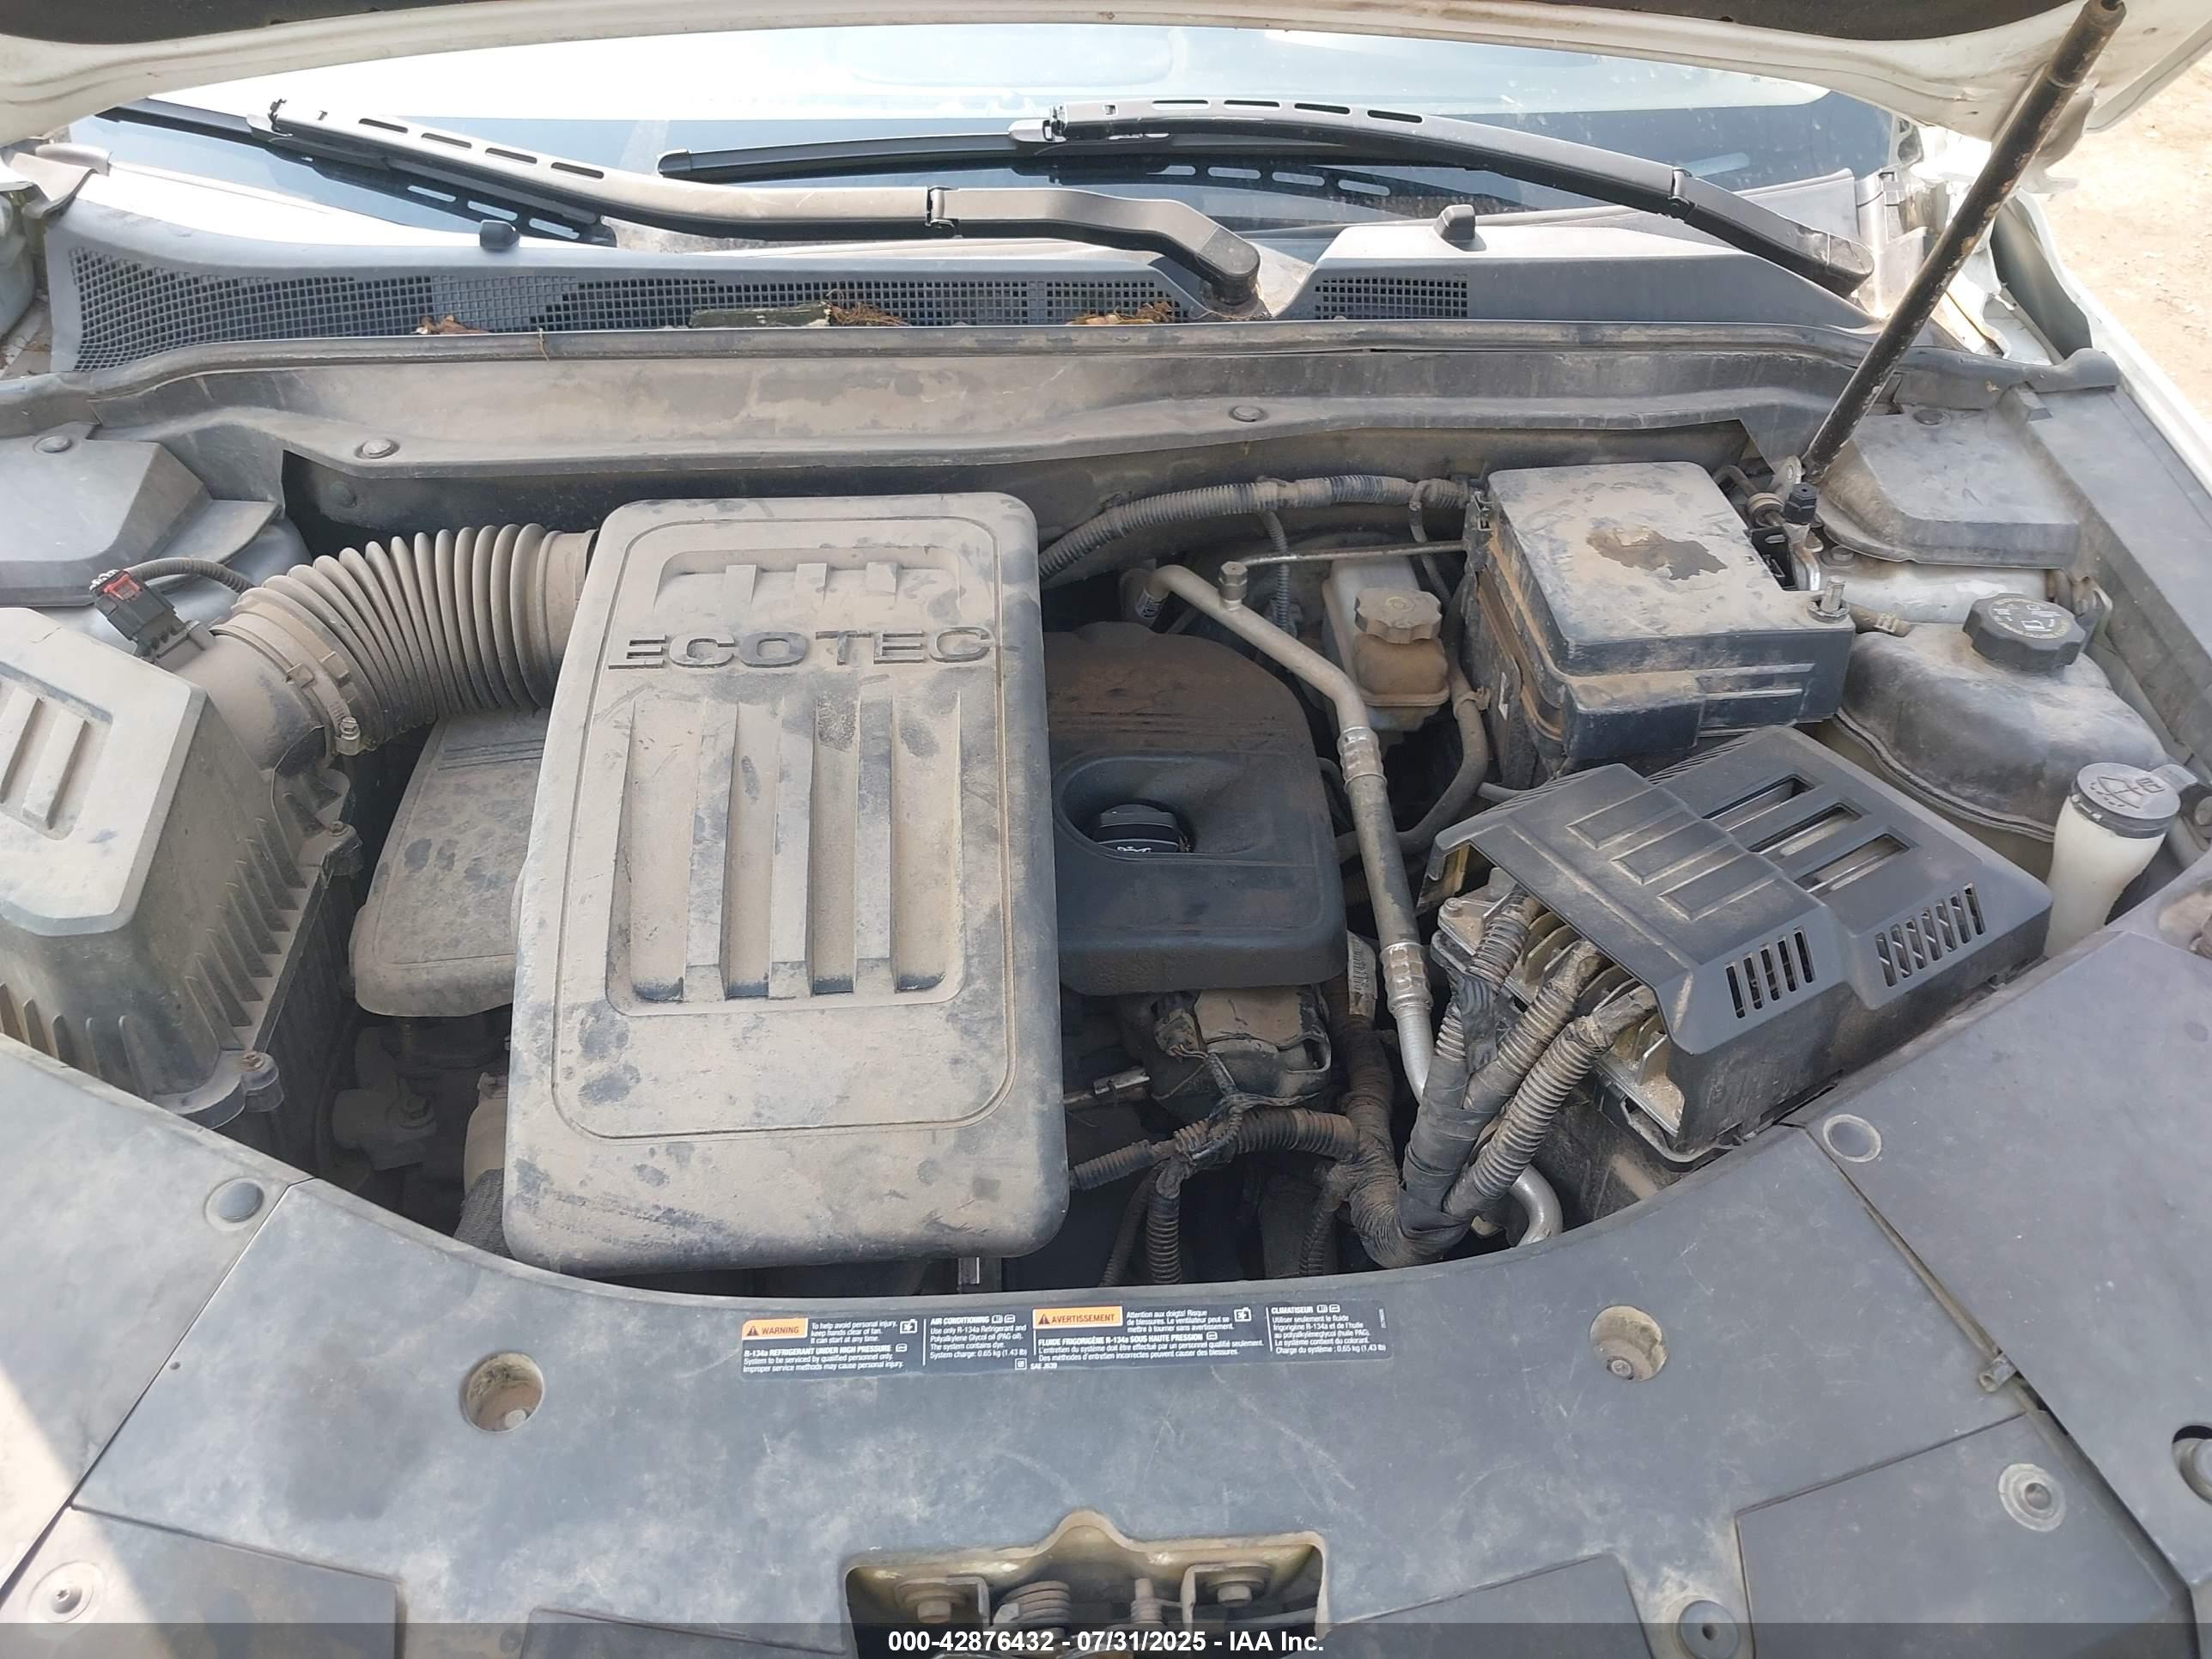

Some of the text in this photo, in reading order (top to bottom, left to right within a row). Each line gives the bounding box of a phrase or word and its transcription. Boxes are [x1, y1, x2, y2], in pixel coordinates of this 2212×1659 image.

[607, 627, 994, 670] ECOTEC
[762, 1326, 799, 1334] WARNING
[981, 1325, 1013, 1334] Refrigerant
[769, 1347, 815, 1356] REFRIGERANT
[817, 1346, 838, 1355] UNDER
